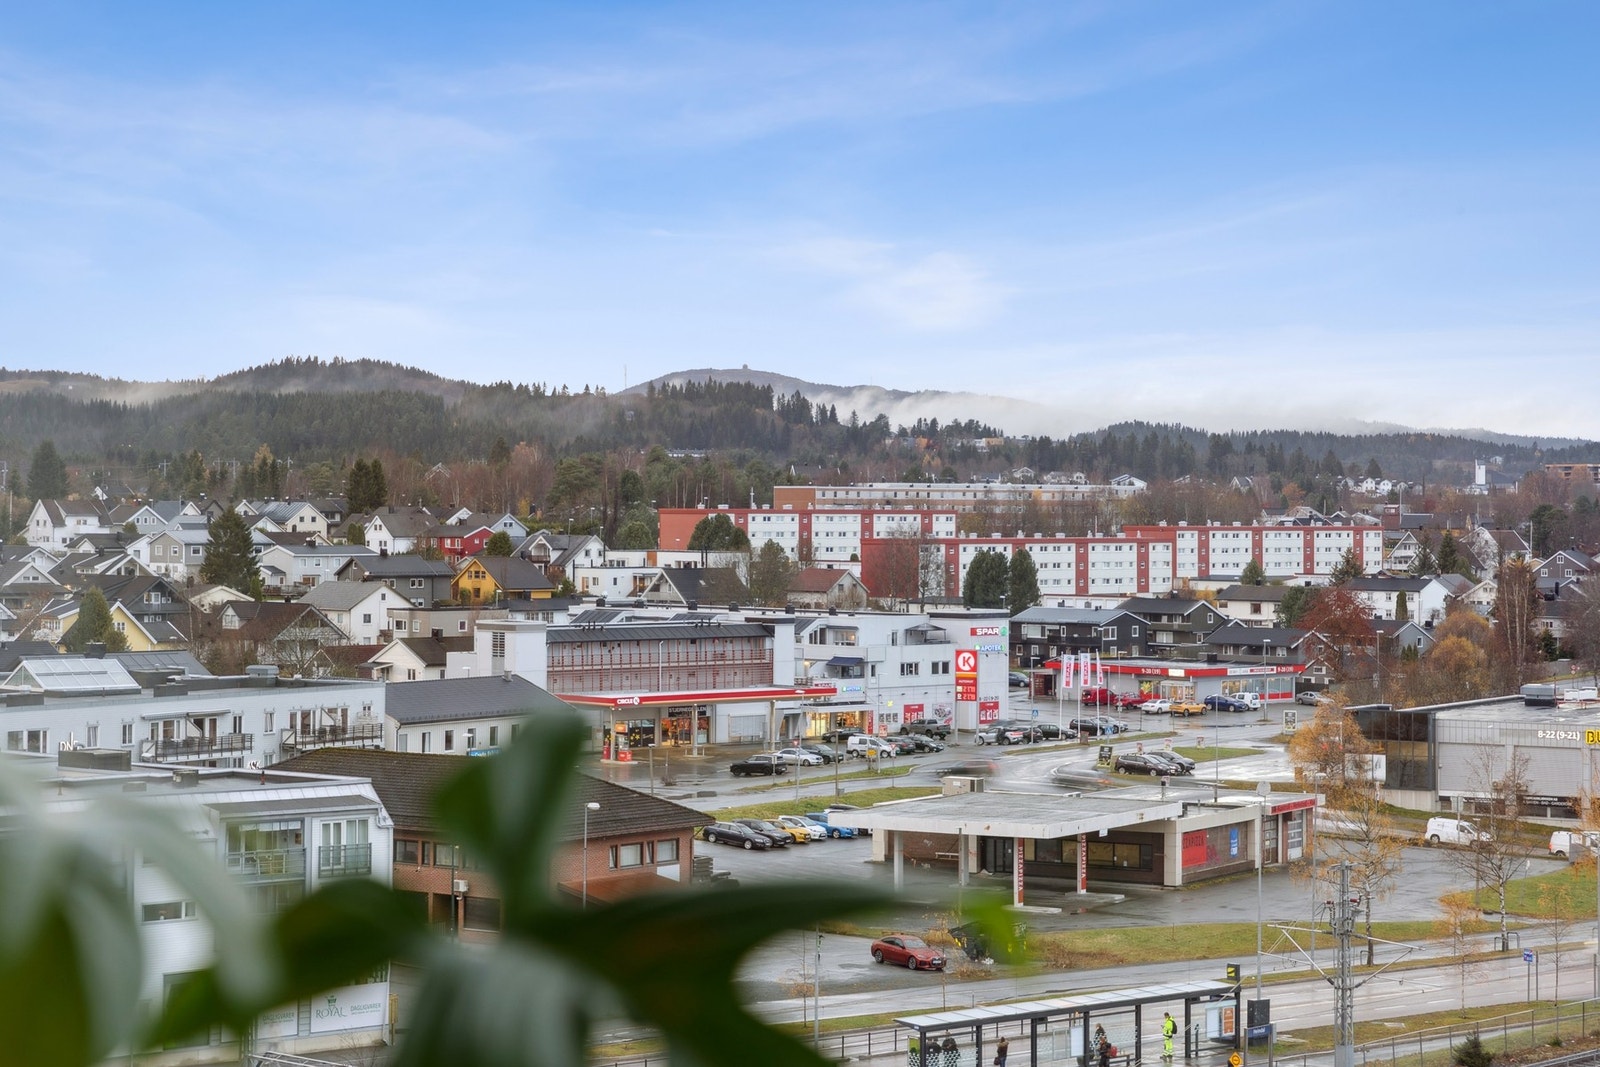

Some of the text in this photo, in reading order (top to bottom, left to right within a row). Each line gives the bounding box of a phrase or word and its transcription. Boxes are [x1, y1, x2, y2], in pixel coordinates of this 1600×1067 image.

[962, 655, 974, 670] K
[1538, 730, 1580, 741] 8-22 (9-21)
[315, 1007, 348, 1019] ROYAL
